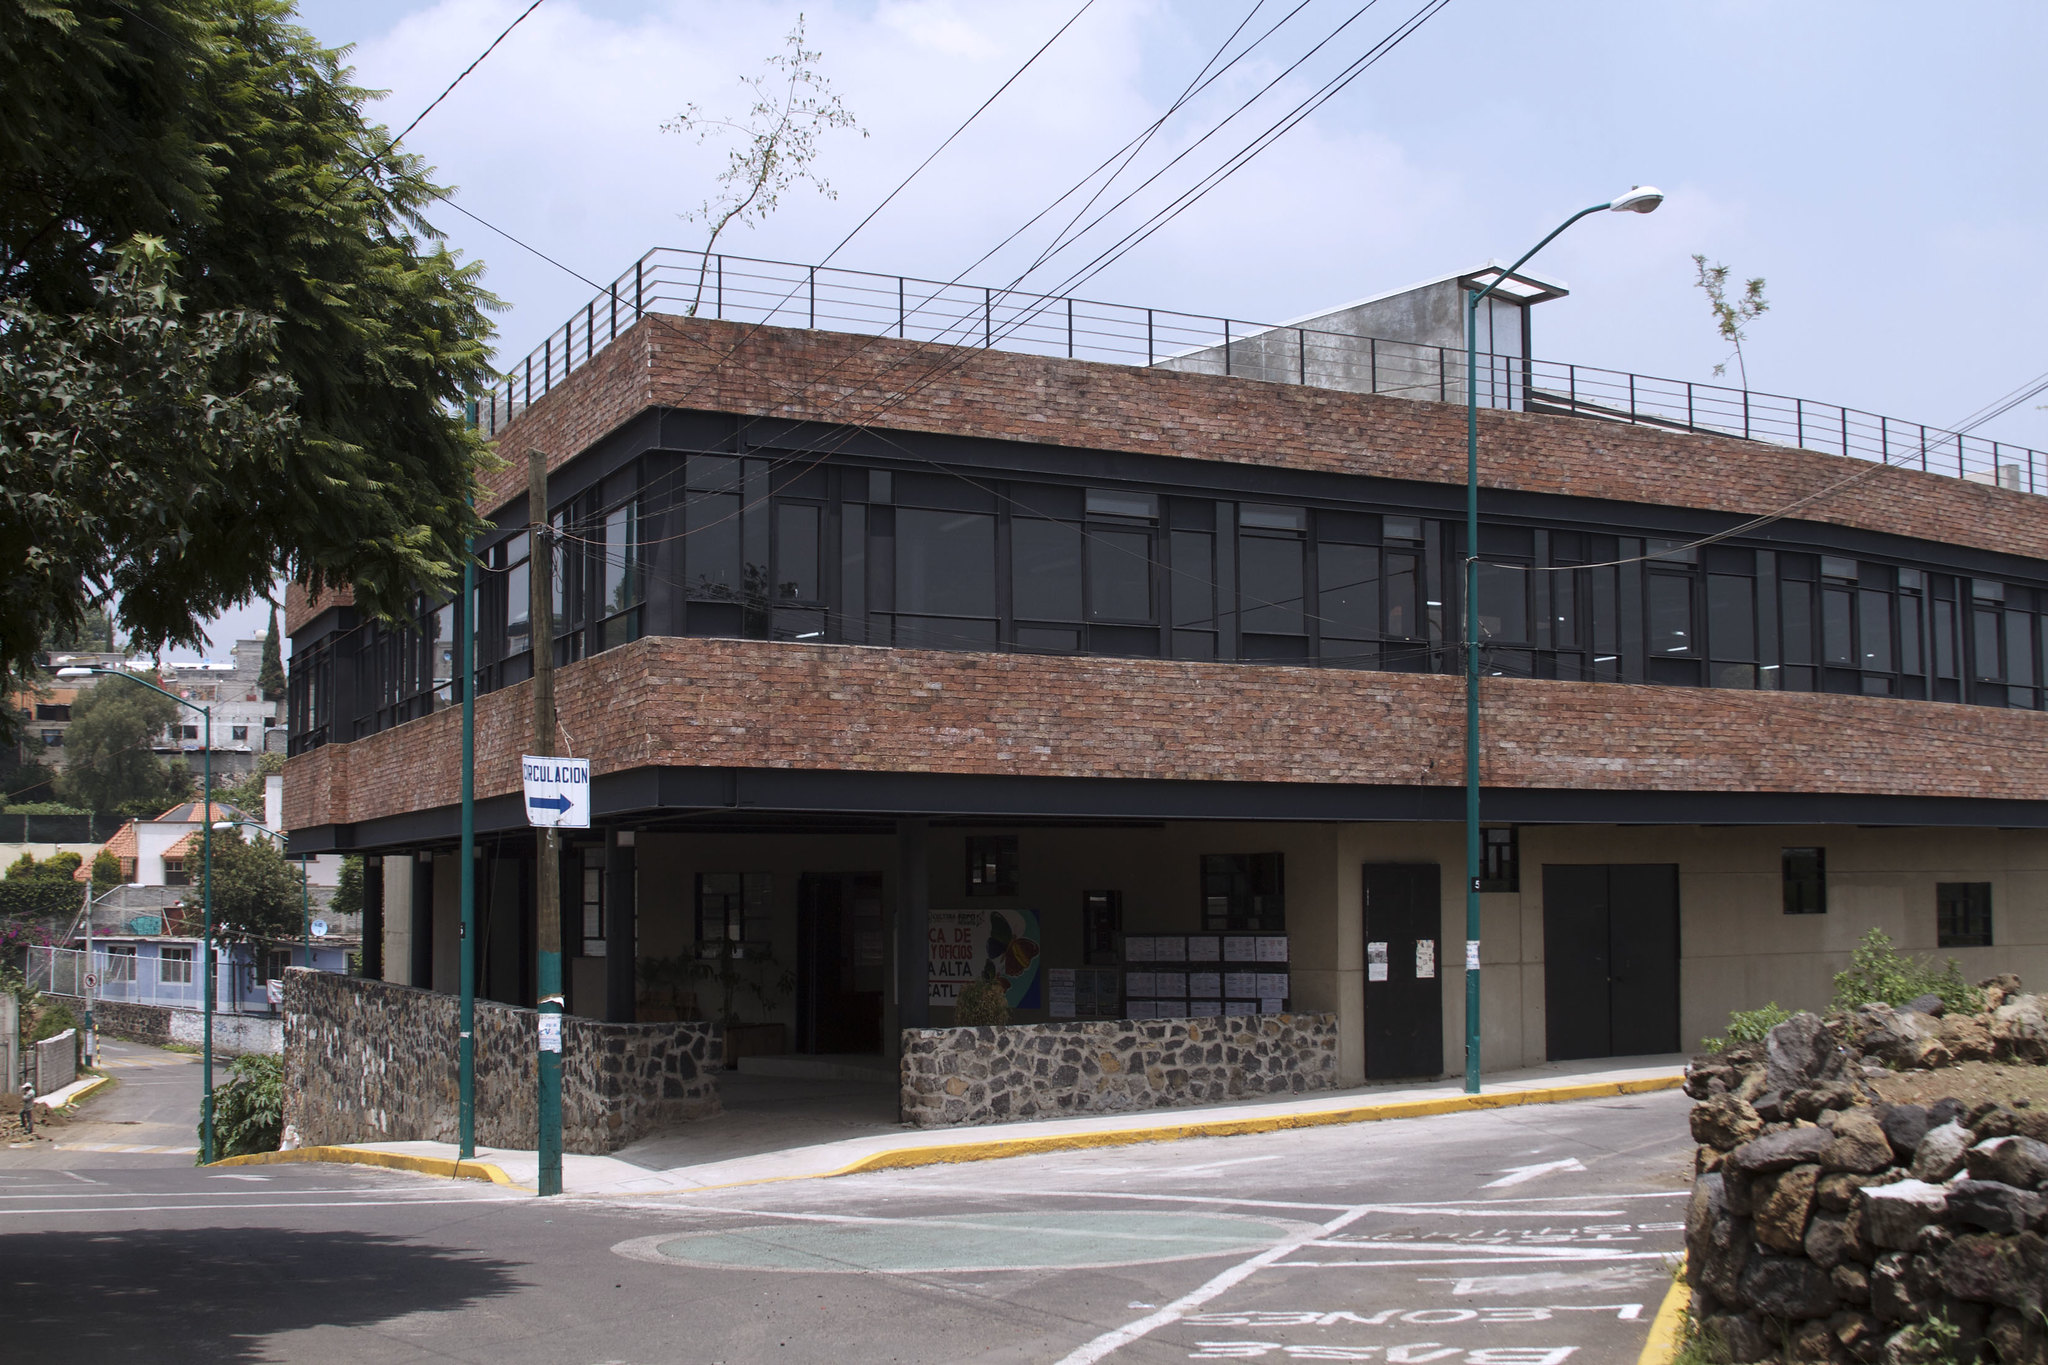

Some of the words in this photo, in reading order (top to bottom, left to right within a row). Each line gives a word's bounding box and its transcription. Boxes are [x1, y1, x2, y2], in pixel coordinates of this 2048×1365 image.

[954, 928, 971, 943] DE
[931, 944, 938, 959] Y
[939, 944, 973, 959] OFICIOS
[939, 961, 972, 976] ALTA
[1182, 1303, 1645, 1327] LEONES
[1187, 1341, 1579, 1365] BASE
